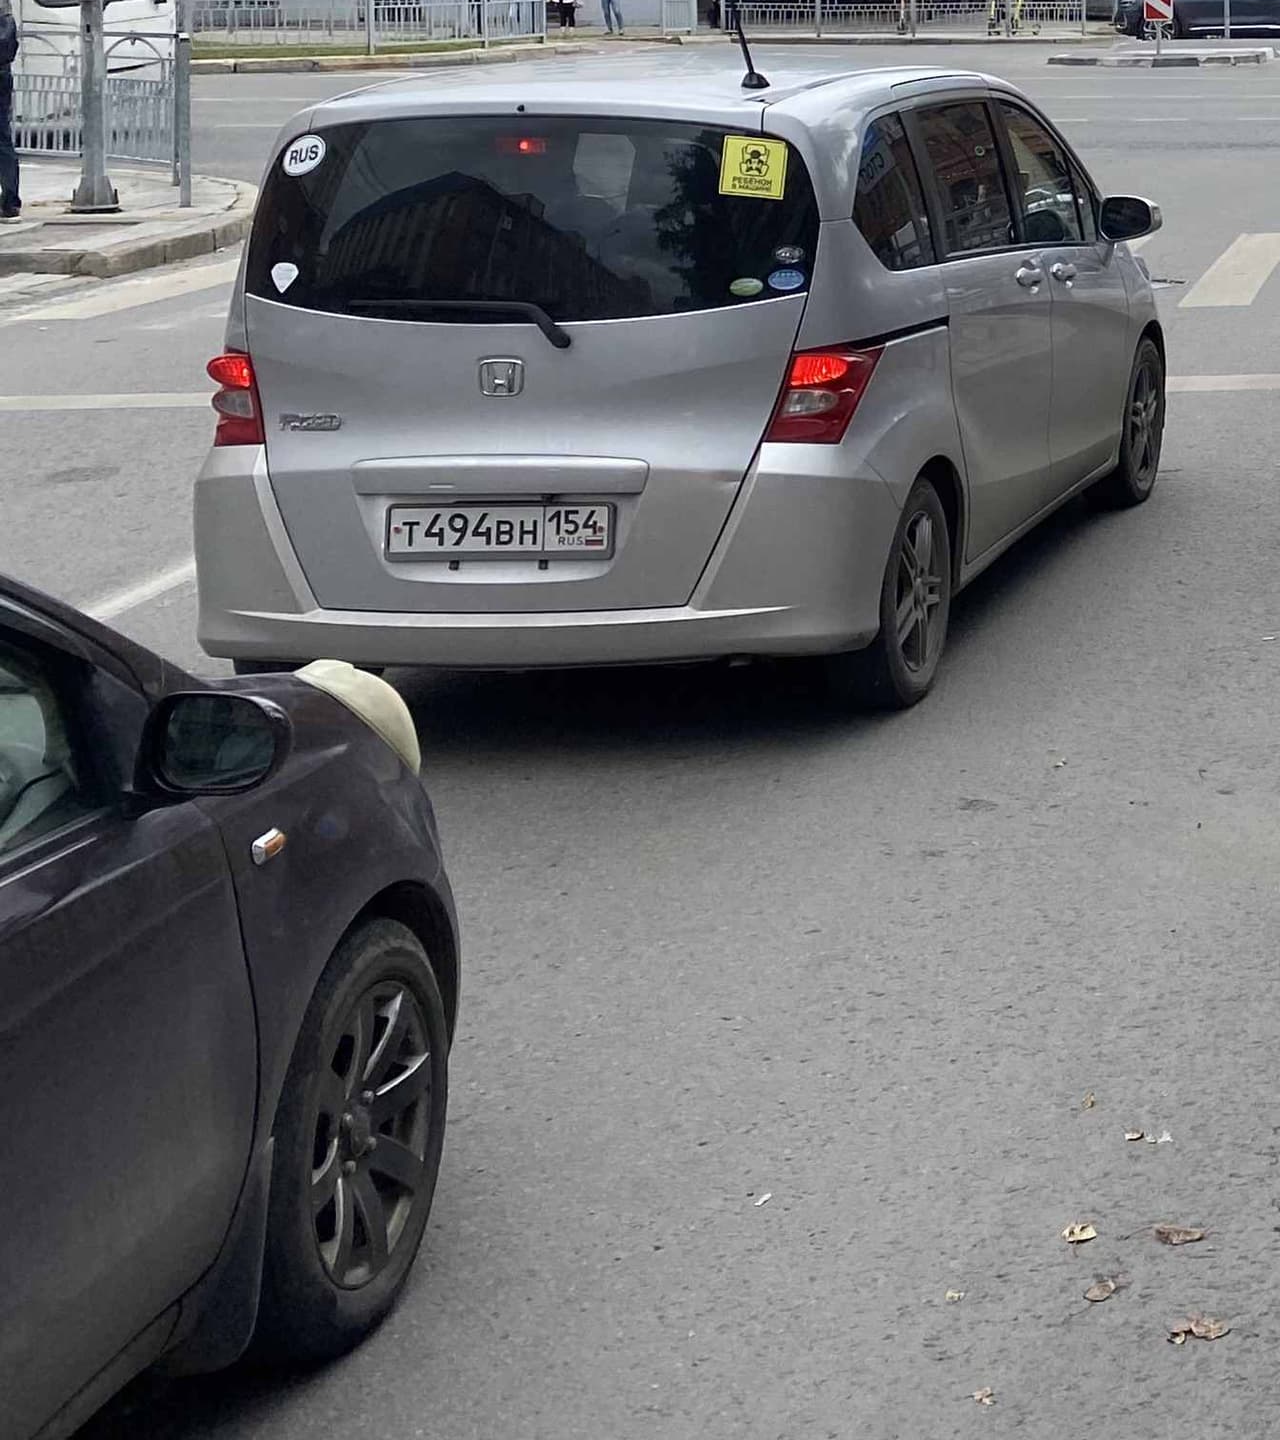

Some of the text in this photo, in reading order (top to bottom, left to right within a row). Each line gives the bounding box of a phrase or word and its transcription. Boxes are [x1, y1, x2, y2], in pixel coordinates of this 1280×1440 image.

[289, 144, 319, 167] RUS
[548, 510, 598, 536] 154
[558, 537, 583, 546] RUS
